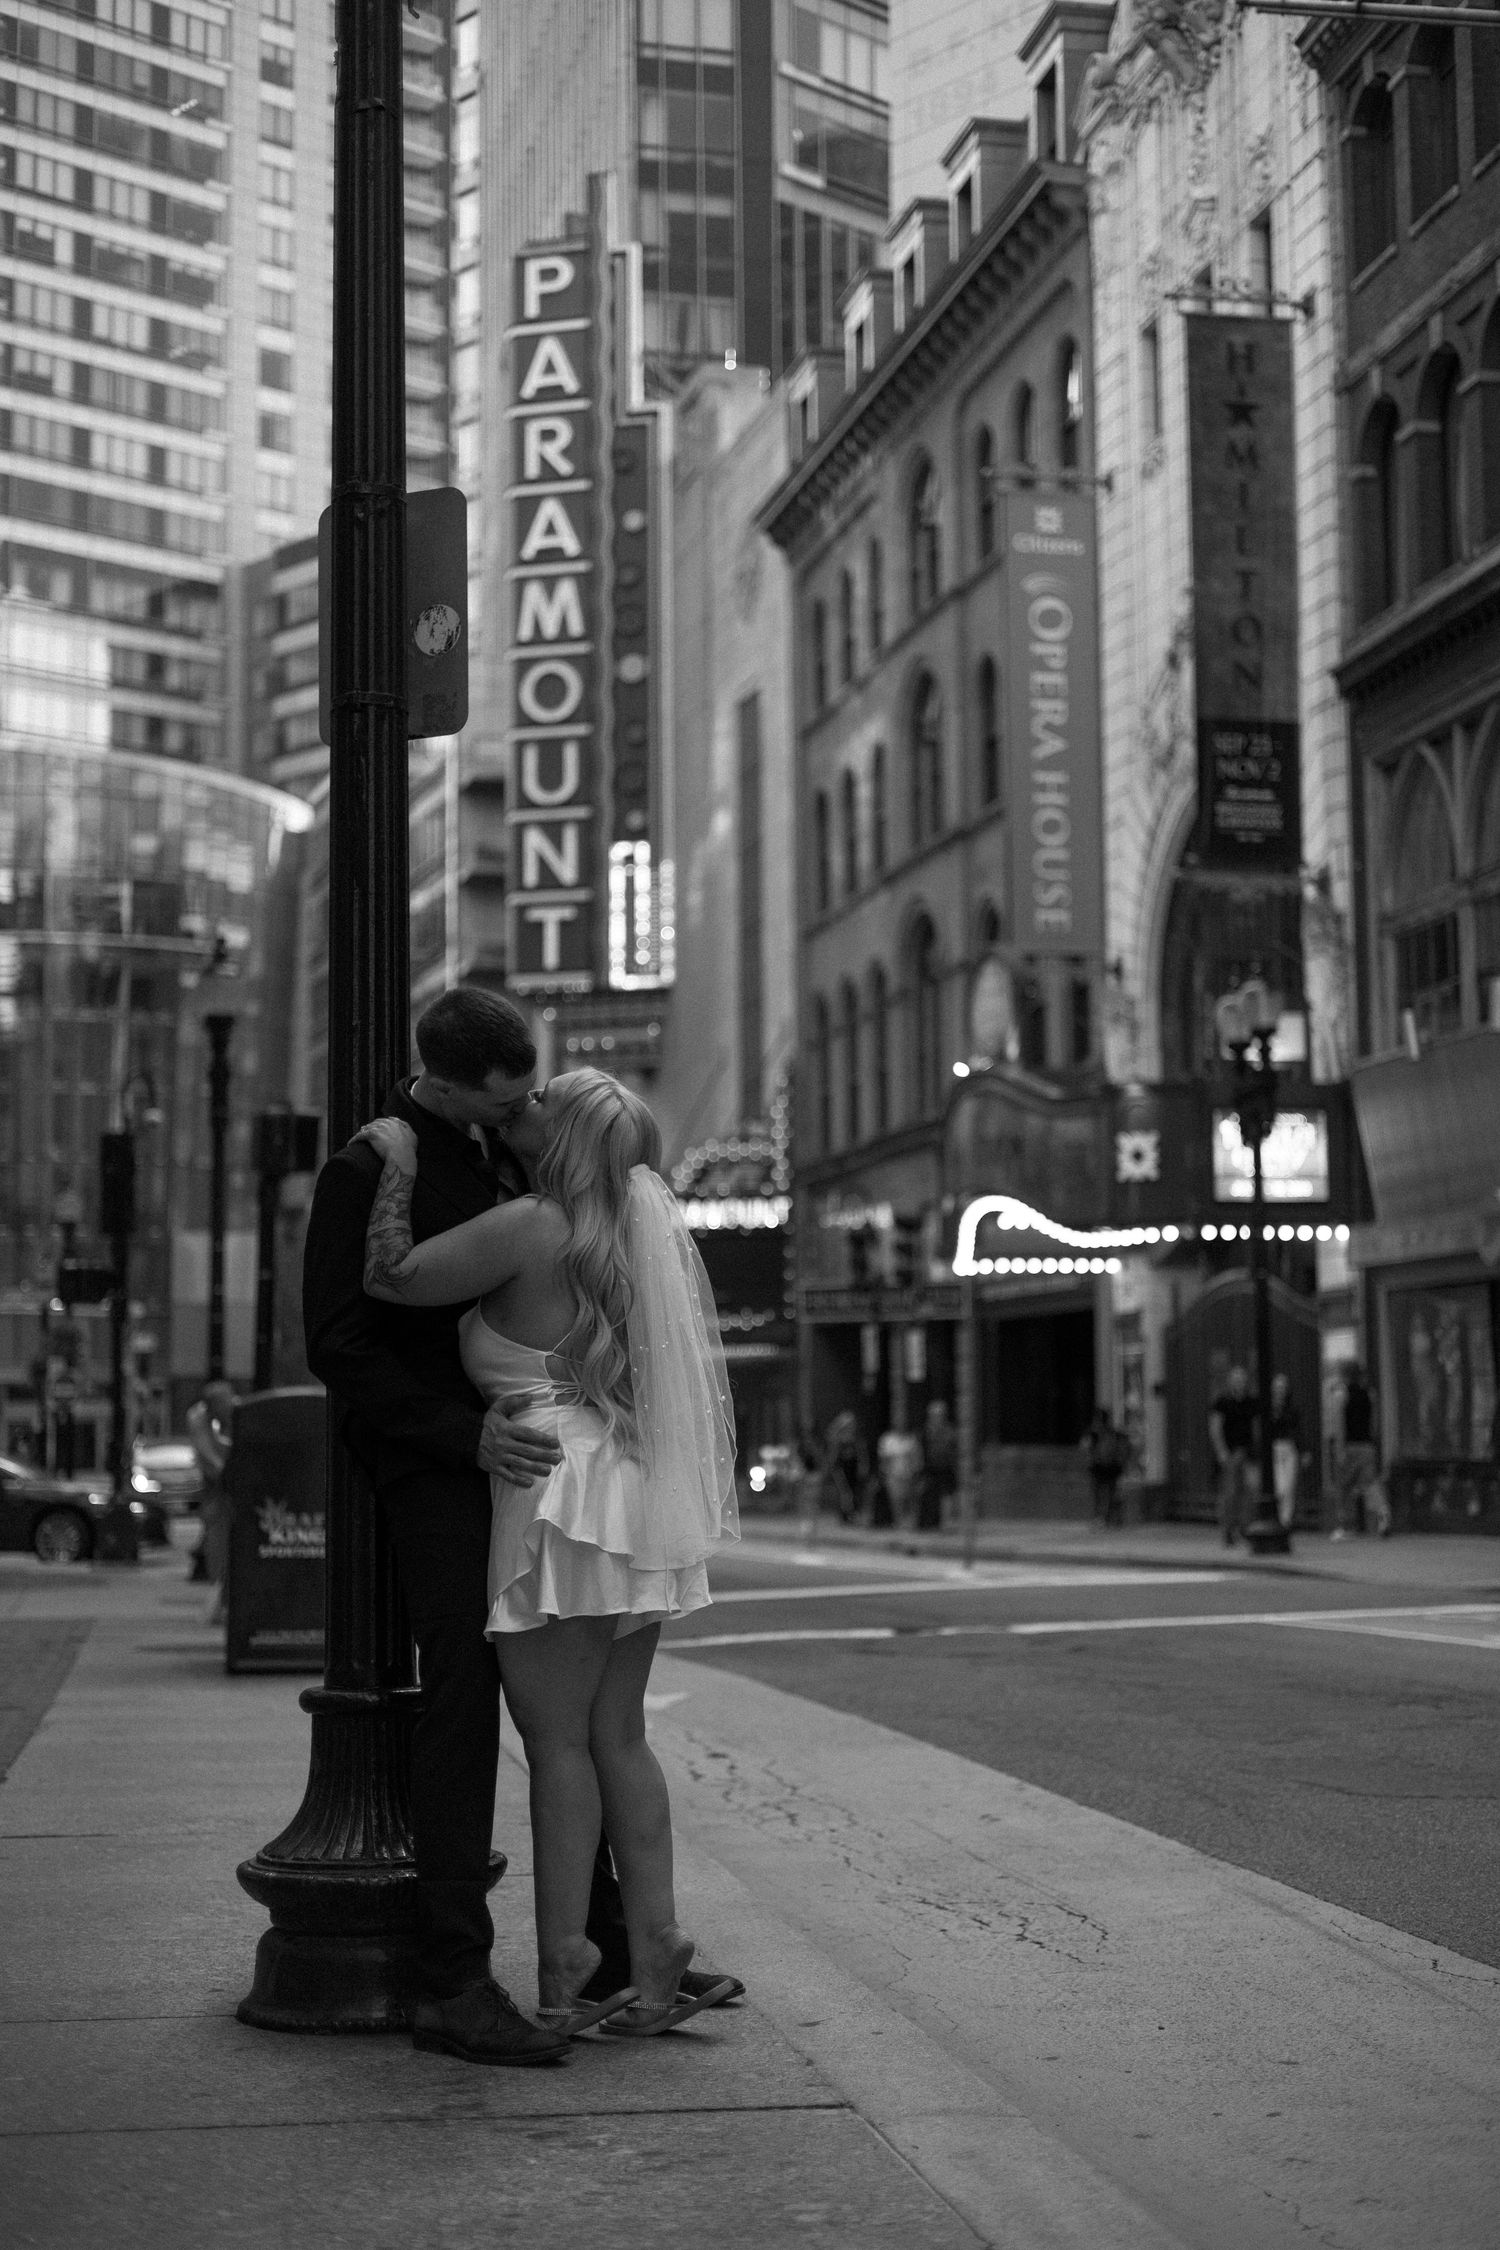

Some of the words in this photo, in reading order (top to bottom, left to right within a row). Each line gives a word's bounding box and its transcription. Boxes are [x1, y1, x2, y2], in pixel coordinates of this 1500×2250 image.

[515, 256, 585, 971] PARAMOUNT
[1027, 595, 1073, 761] OPERA
[1030, 769, 1073, 934] HOUSE
